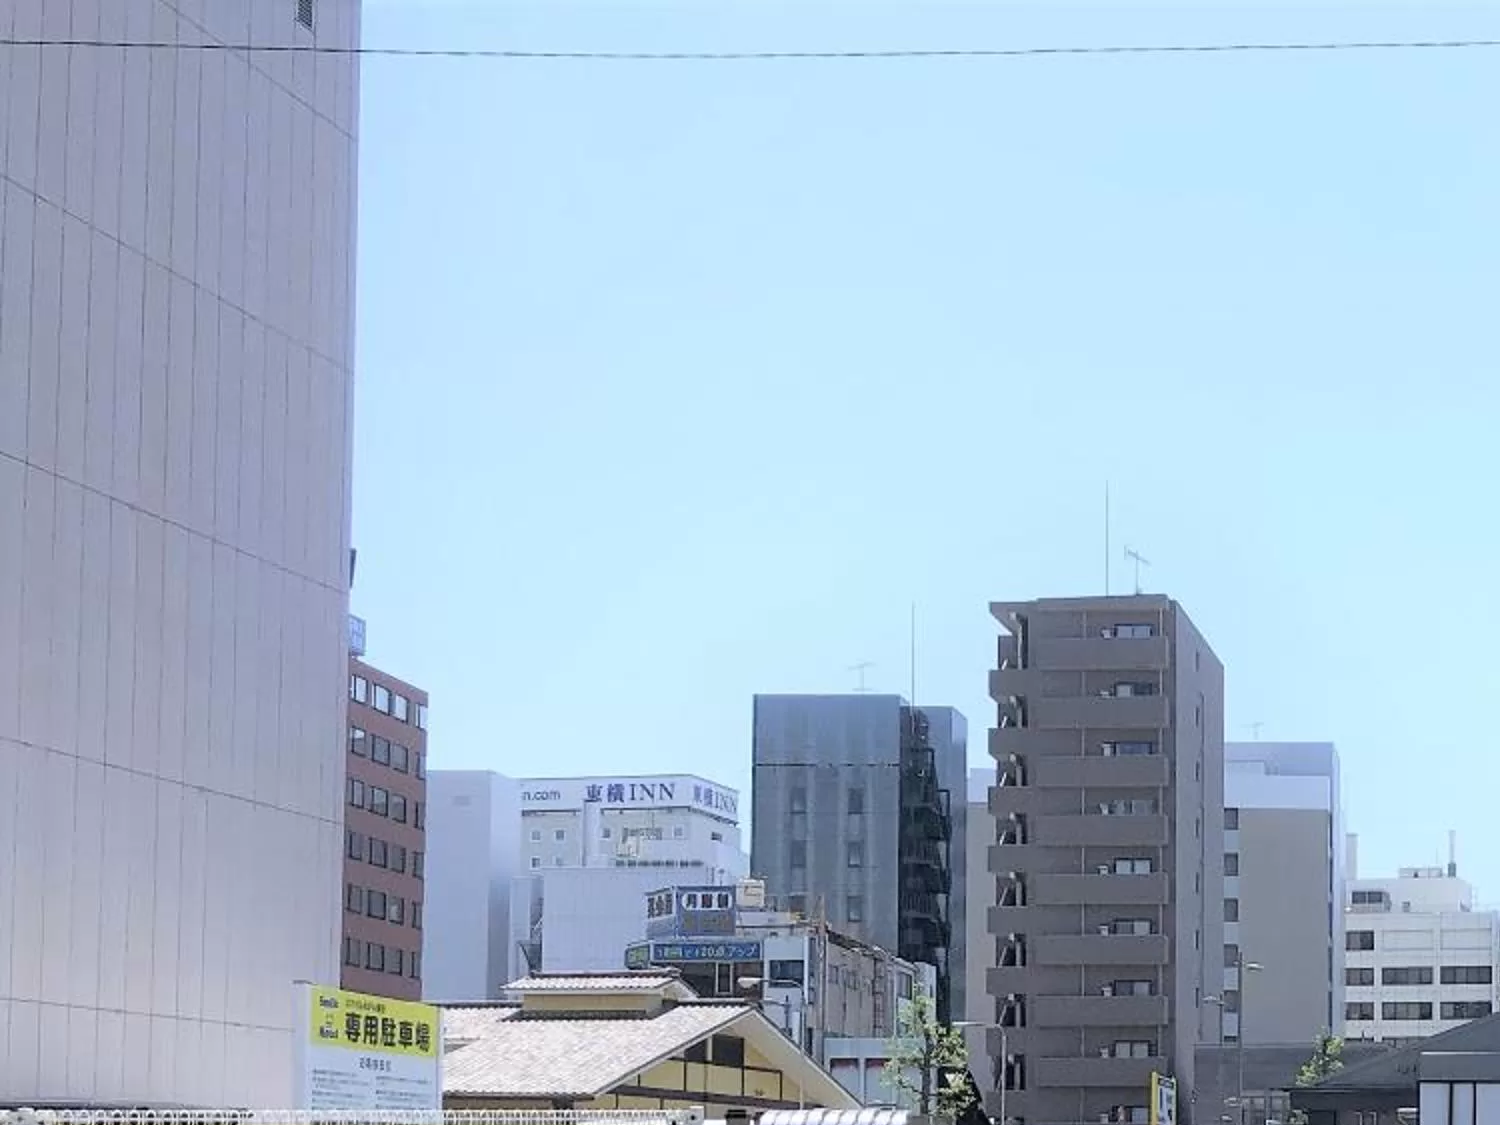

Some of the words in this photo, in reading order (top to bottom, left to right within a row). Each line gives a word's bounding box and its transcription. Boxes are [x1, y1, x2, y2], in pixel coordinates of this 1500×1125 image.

[345, 1011, 431, 1053] 専用駐車場
